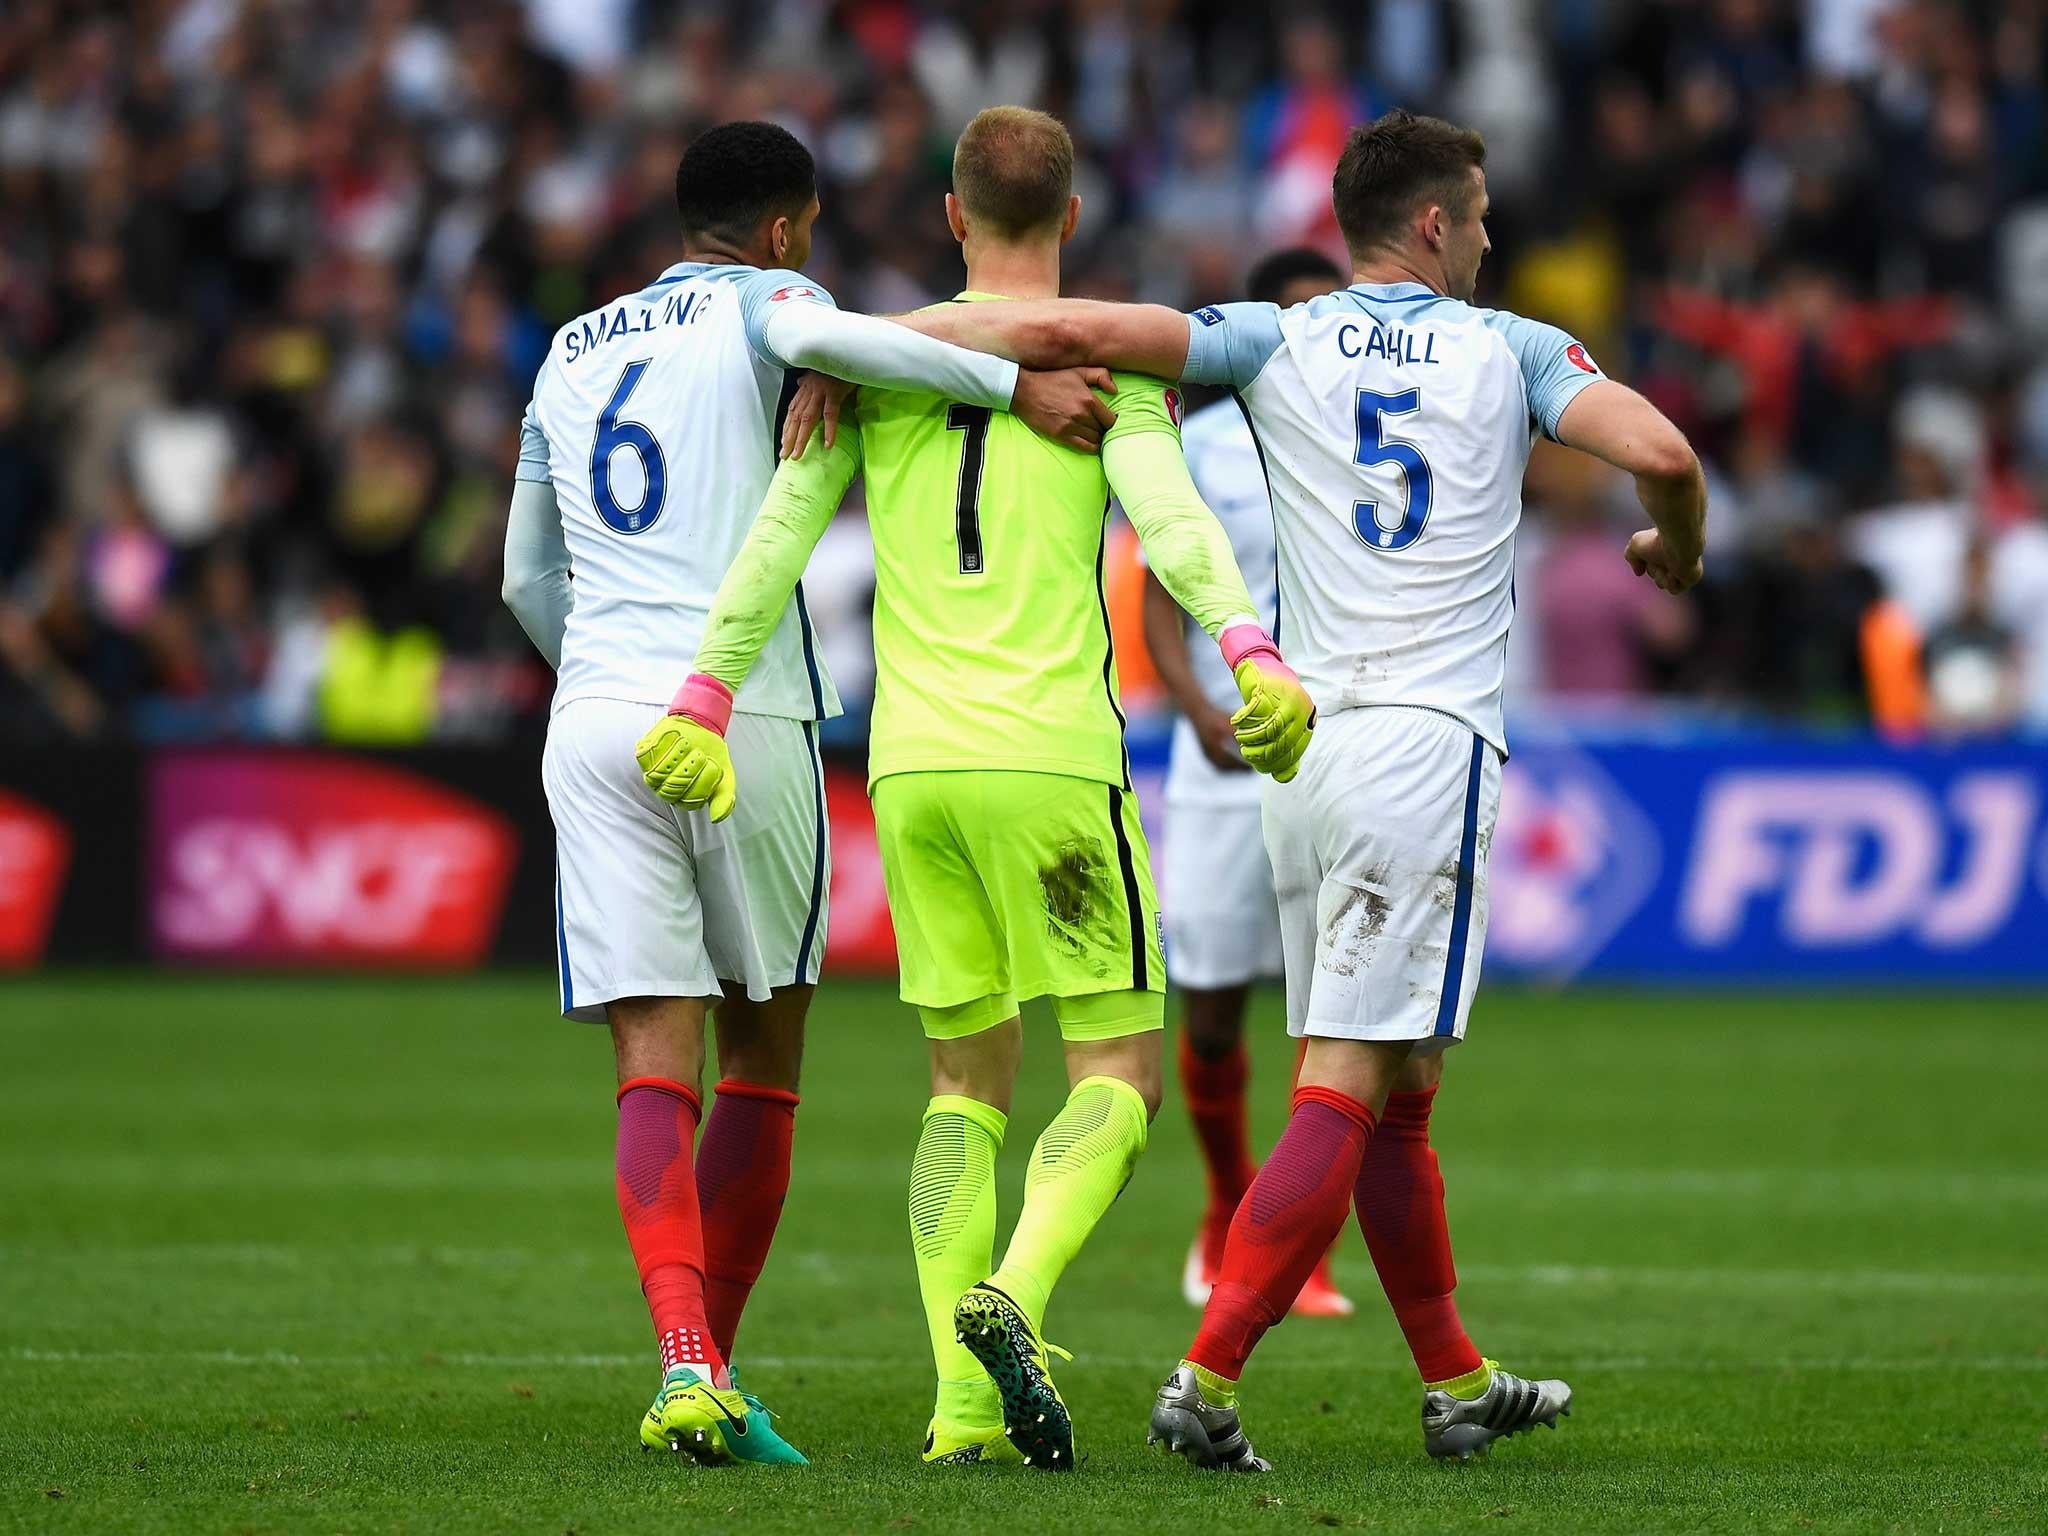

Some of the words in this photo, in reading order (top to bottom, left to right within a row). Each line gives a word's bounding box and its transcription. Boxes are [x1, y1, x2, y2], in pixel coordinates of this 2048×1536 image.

[589, 356, 668, 536] 6
[946, 403, 993, 575] 1
[1352, 387, 1434, 553] 5
[1684, 768, 2036, 950] FDJ
